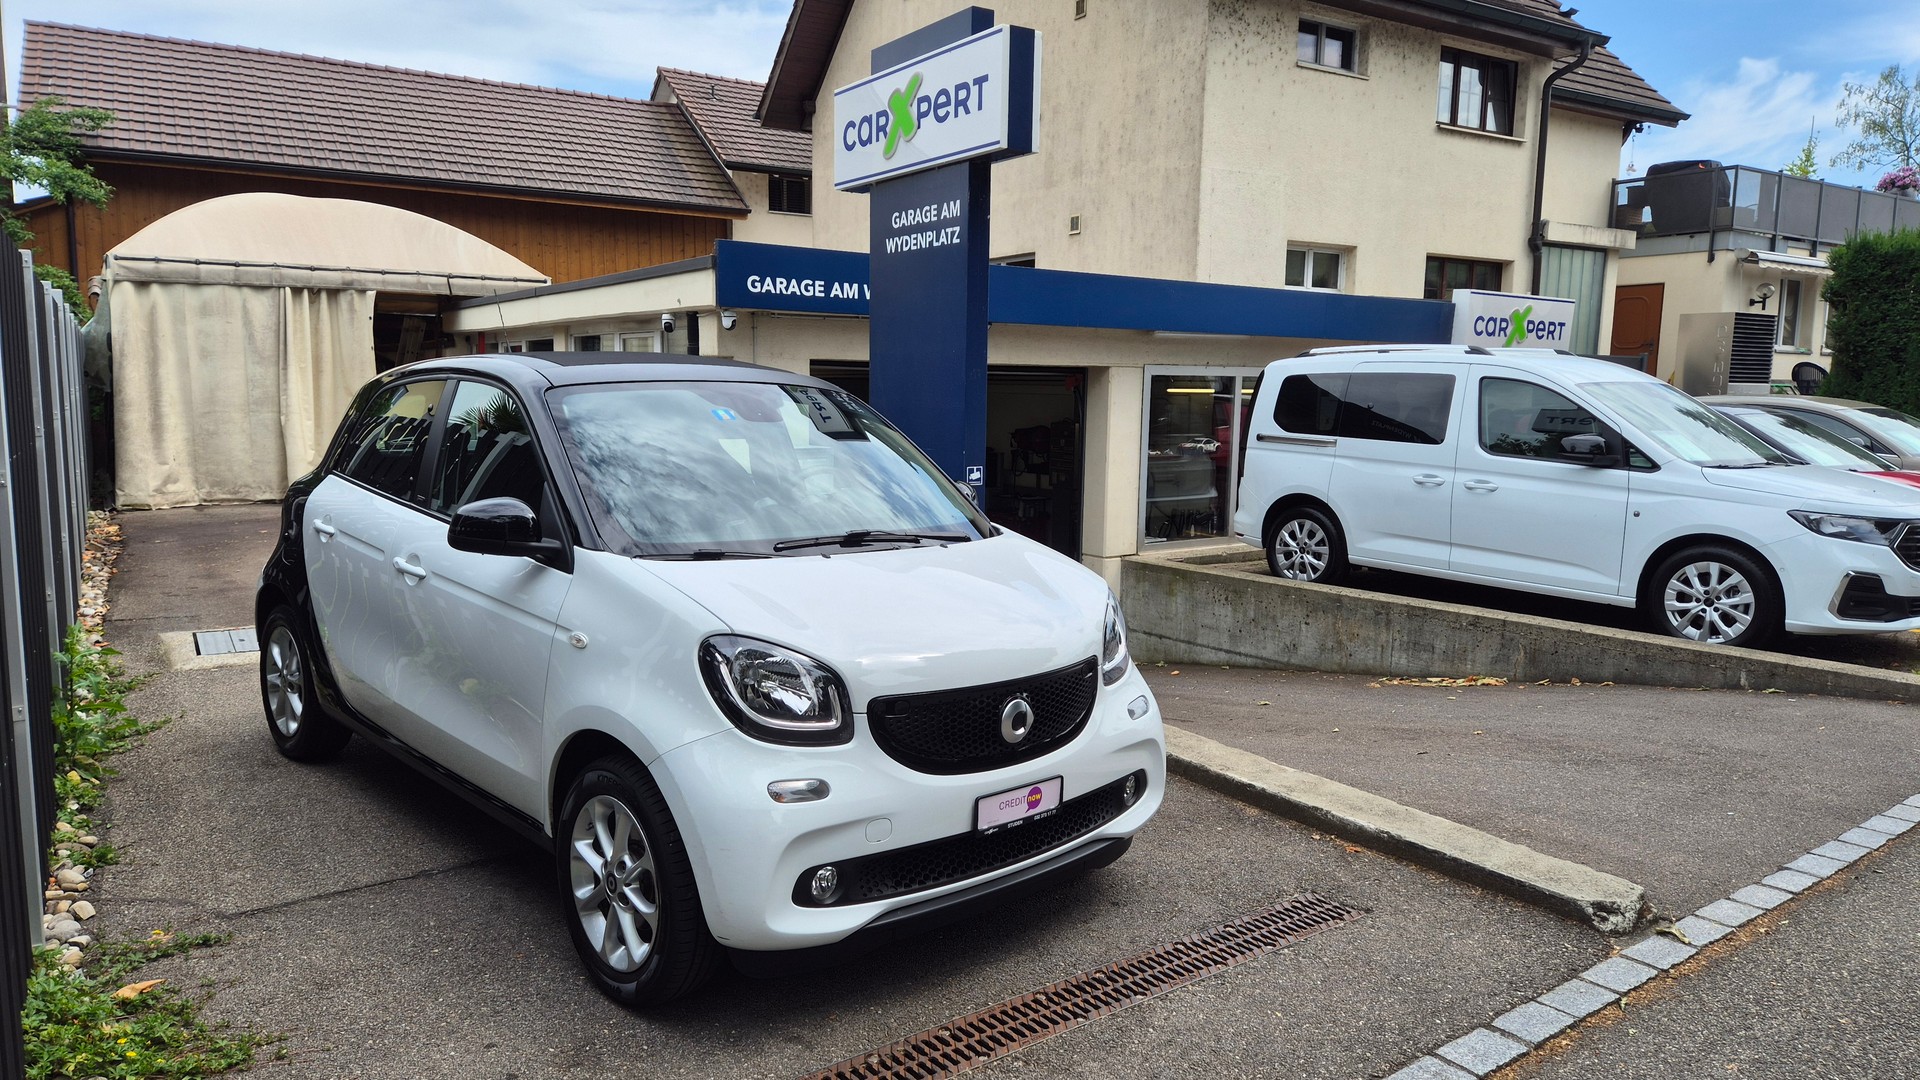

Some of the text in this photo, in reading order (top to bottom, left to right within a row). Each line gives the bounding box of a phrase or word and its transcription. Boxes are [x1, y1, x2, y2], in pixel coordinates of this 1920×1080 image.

[892, 199, 961, 229] GARAGE AM
[886, 226, 961, 254] WYDENPLATZ
[747, 275, 825, 298] GARAGE
[830, 282, 859, 300] AM
[999, 793, 1041, 810] CREDIT now
[1008, 820, 1023, 828] STUDEN
